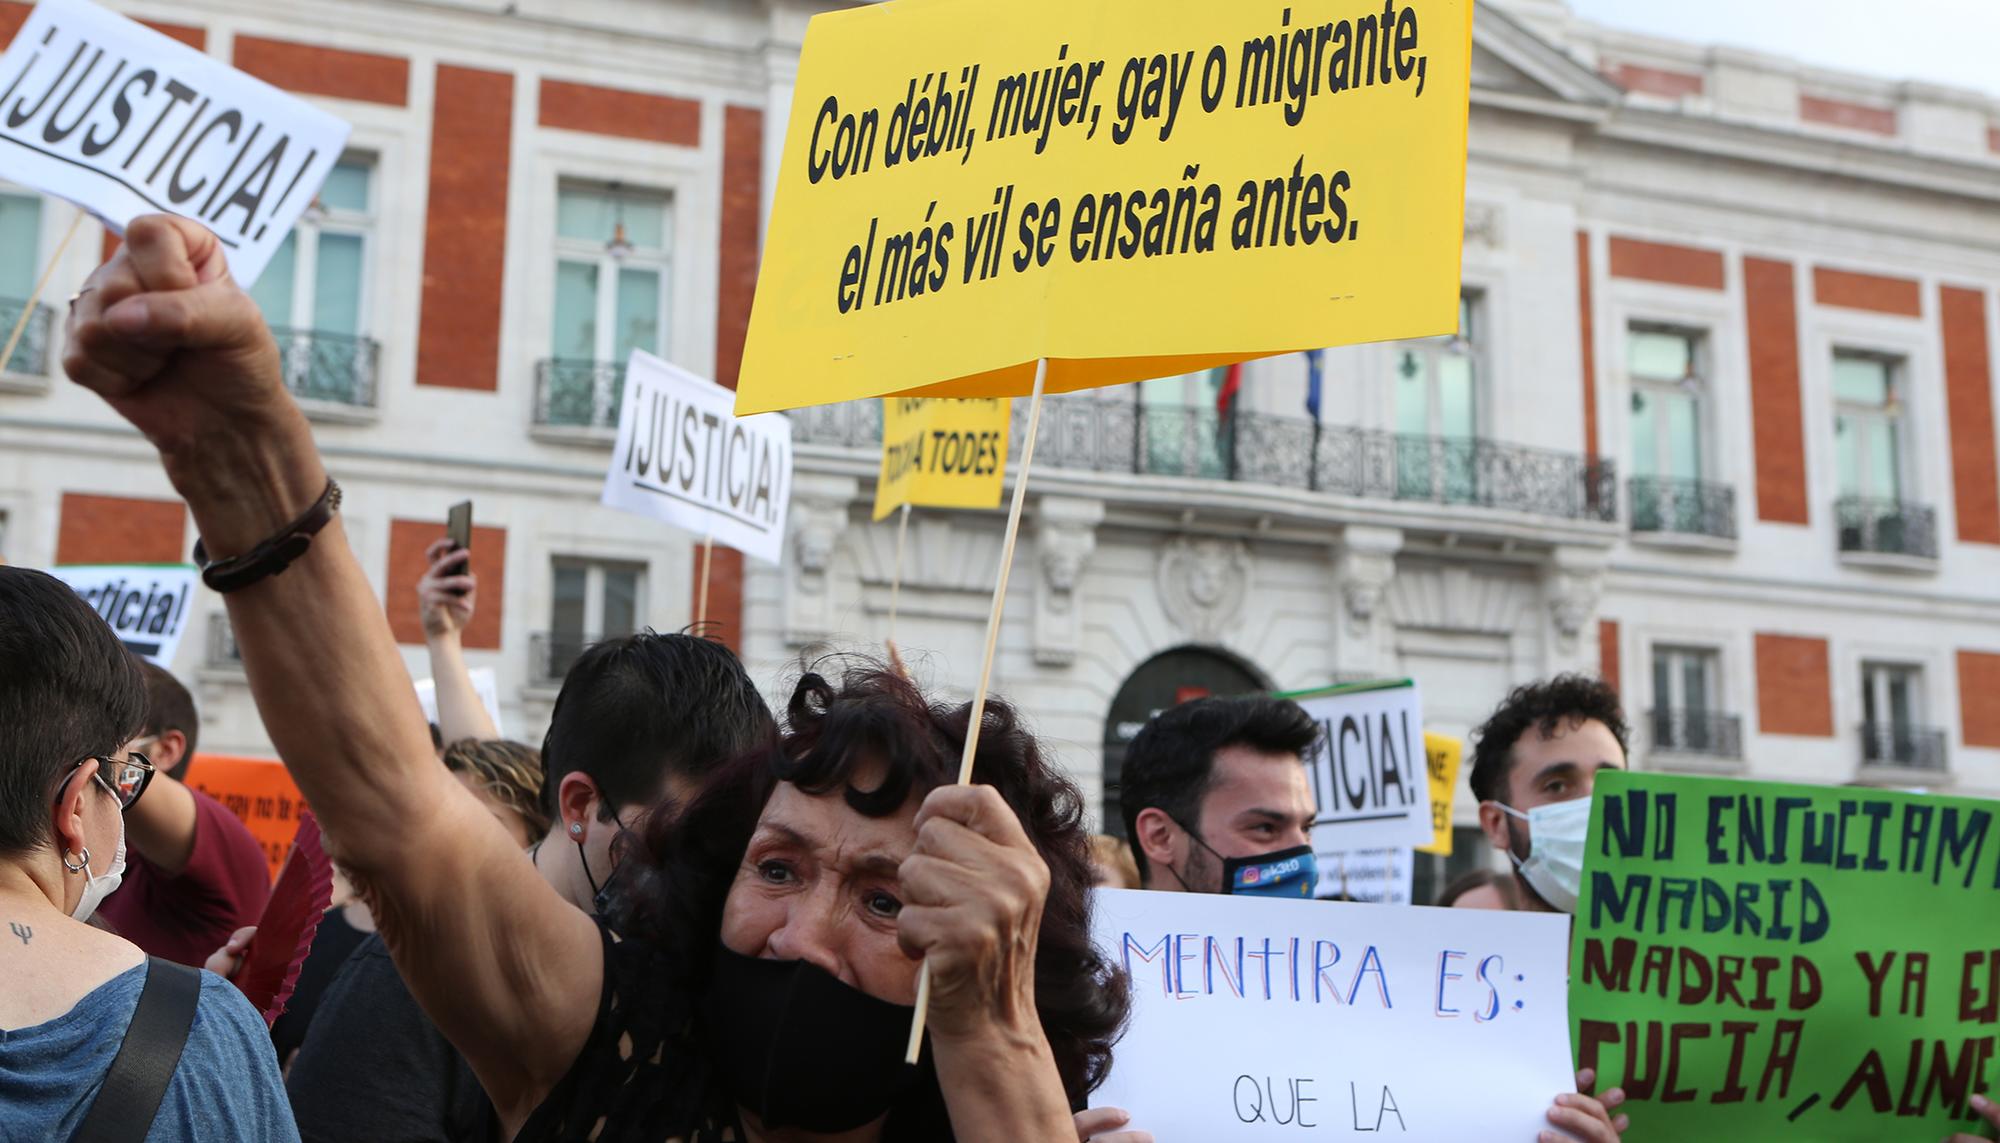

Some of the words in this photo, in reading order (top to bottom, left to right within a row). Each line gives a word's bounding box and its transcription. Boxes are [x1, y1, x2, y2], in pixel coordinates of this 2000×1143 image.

[0, 26, 317, 241] ¡JUSTICIA!
[808, 95, 879, 185] Con
[884, 63, 980, 166] débil,
[985, 44, 1105, 155] mujer,
[1112, 51, 1195, 145] gay
[1201, 45, 1227, 113] o
[1235, 0, 1427, 126] migrante,
[838, 217, 878, 314] el
[874, 201, 954, 306] más
[963, 184, 1014, 284] vil
[1013, 197, 1061, 273] se
[1070, 163, 1222, 263] ensaña
[1231, 154, 1358, 250] antes.
[625, 384, 784, 526] ¡JUSTICIA!
[929, 430, 999, 475] TODES
[1312, 709, 1415, 814] TICIA!
[1602, 790, 1677, 860] NO
[1706, 794, 2000, 889] ENSUCIAM
[1590, 870, 1830, 944] MADRID
[1120, 932, 1393, 1009] MENTIRA
[1435, 950, 1525, 1023] ES:
[1582, 937, 1823, 1010] MADRID
[1855, 951, 1930, 1018] YA
[1233, 1075, 1318, 1128] QUE
[1350, 1081, 1407, 1132] LA
